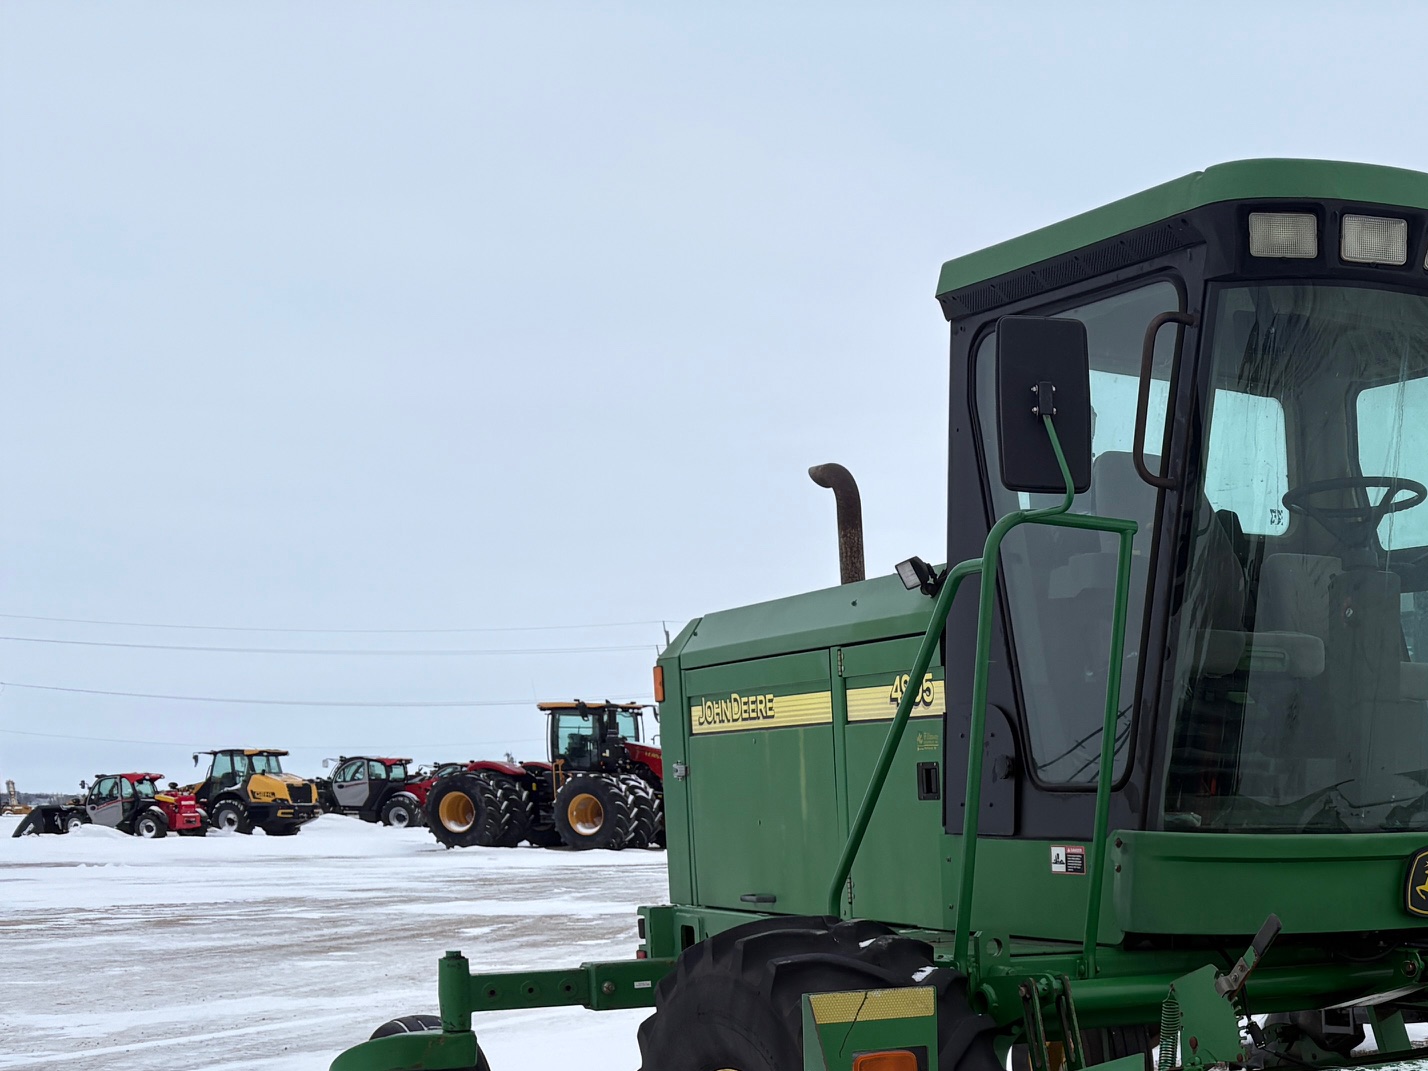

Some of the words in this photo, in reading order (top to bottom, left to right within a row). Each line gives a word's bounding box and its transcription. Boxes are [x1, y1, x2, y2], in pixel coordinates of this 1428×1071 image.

[890, 672, 935, 708] 495
[698, 697, 731, 726] JOHN
[730, 692, 775, 722] DEERE
